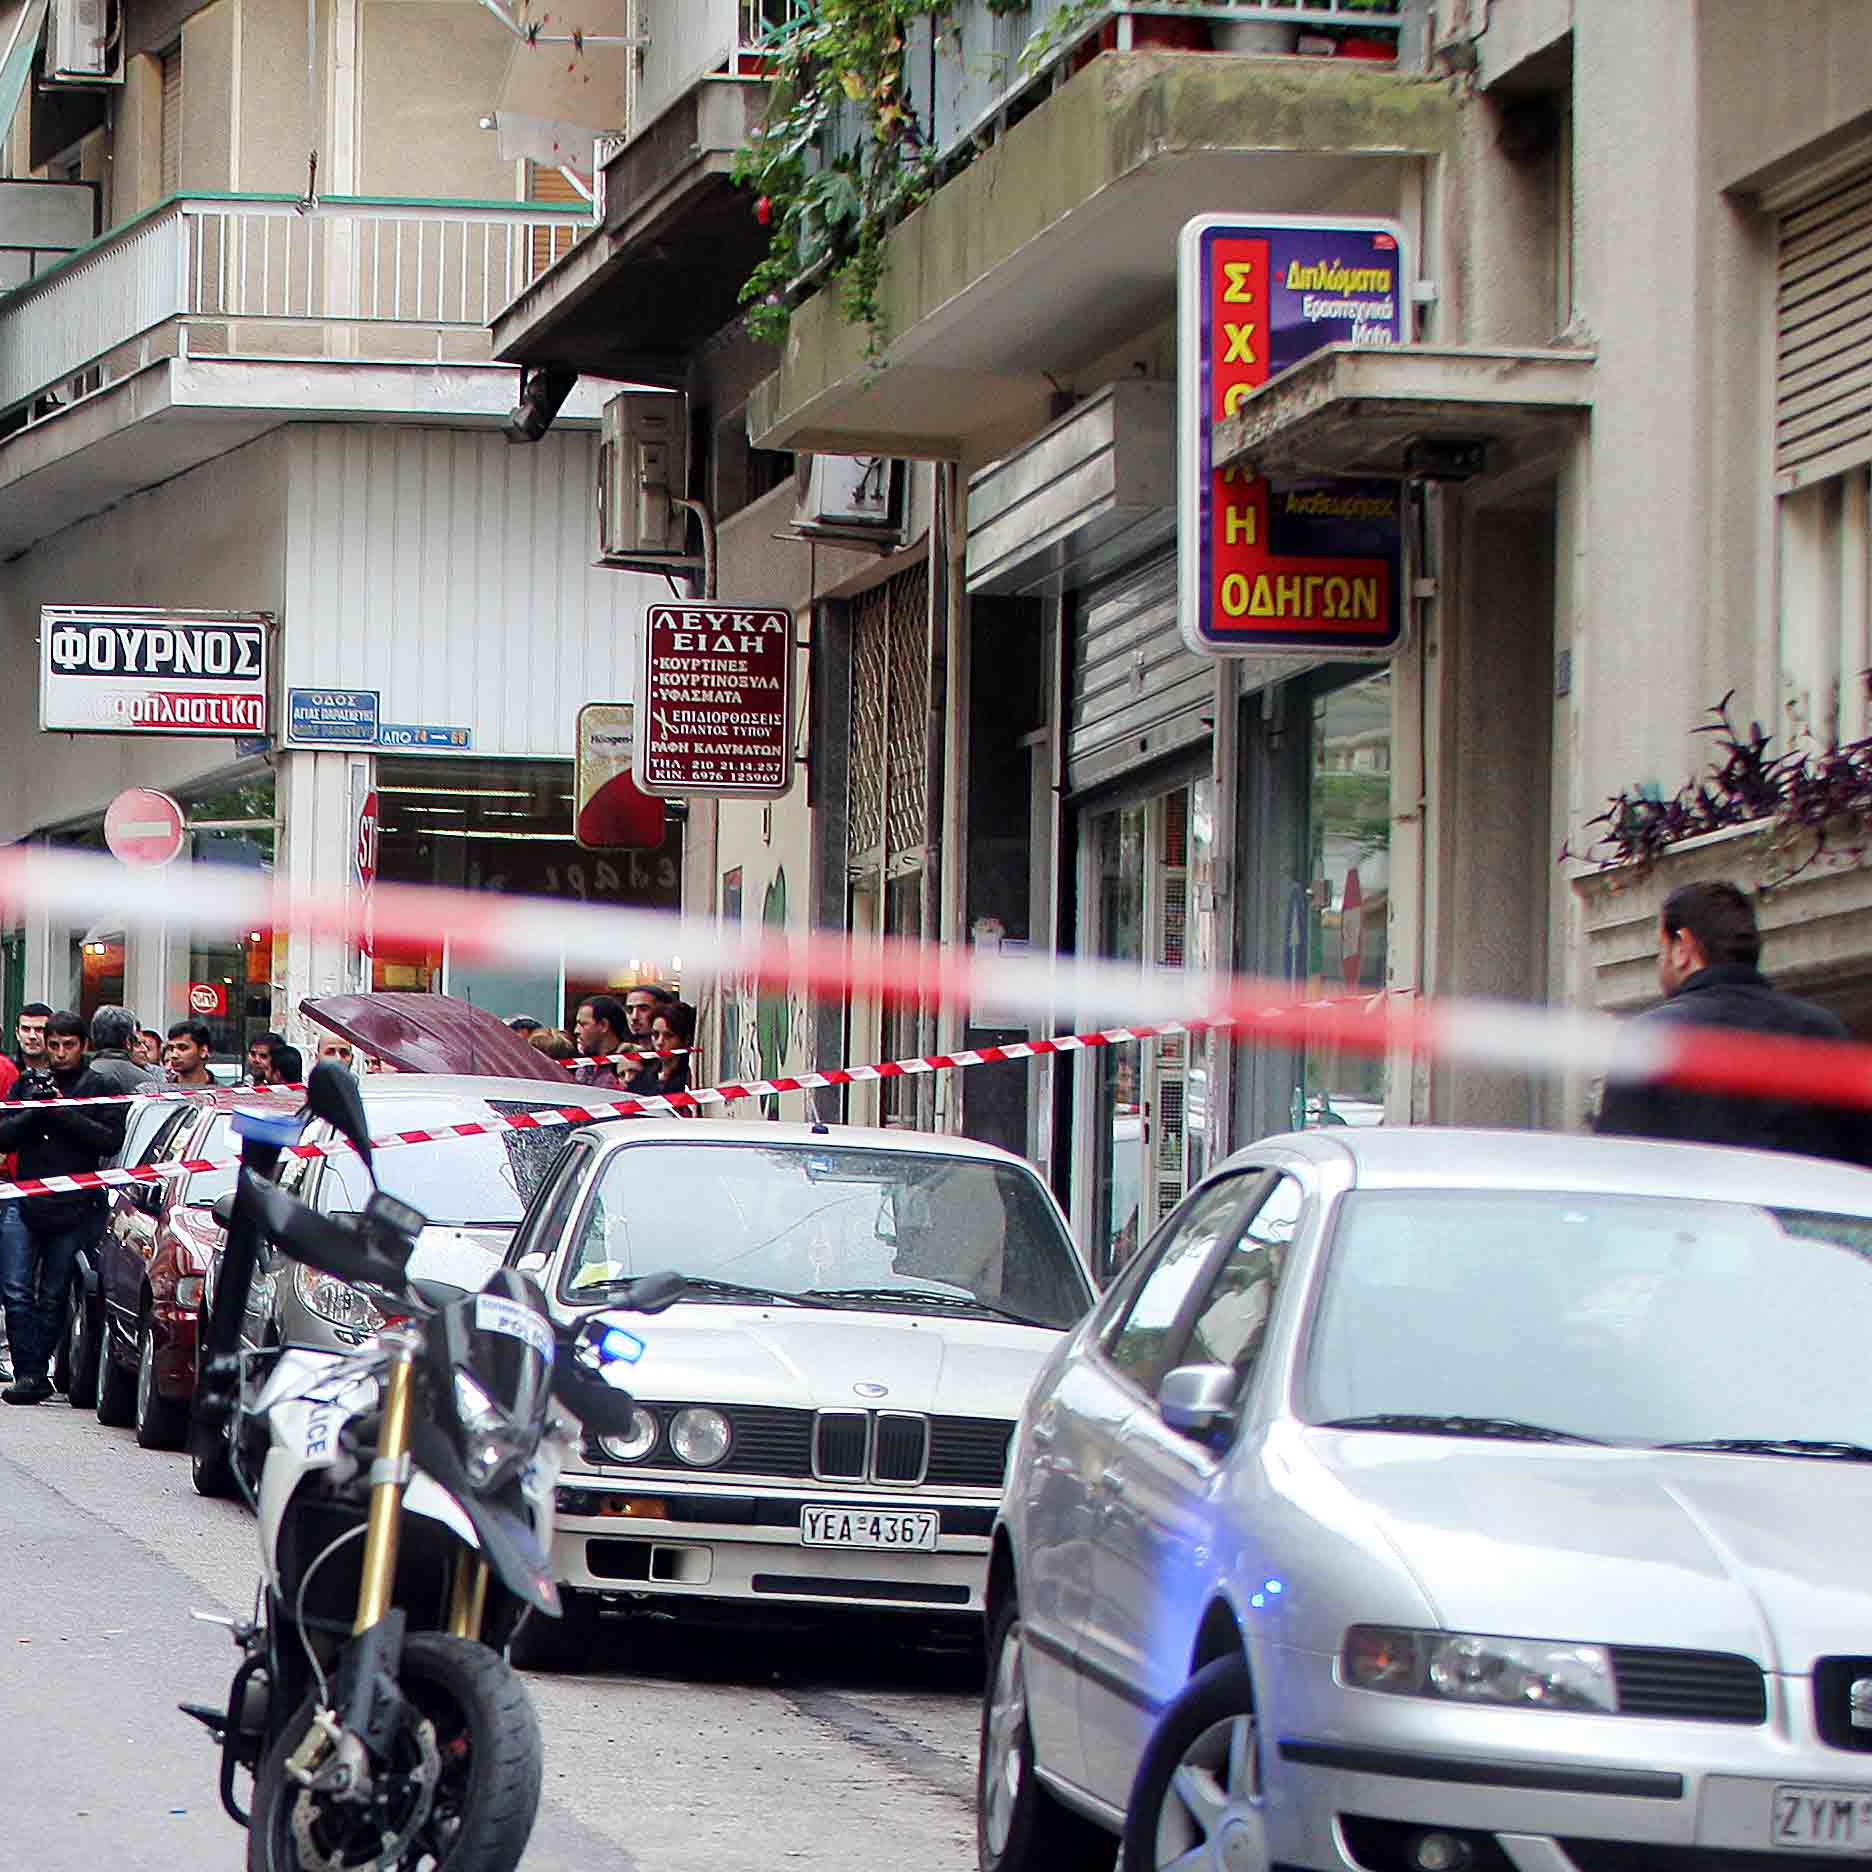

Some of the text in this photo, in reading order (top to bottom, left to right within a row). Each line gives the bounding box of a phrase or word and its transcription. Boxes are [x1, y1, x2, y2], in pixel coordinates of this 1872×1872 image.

[1221, 573, 1378, 620] ΟΔΗΓΩΝ
[655, 611, 784, 633] ΛΕΥΚΑ
[52, 627, 260, 676] ΦΟΥΡΝΟΣ
[673, 633, 764, 654] ΕΙΔΗ
[659, 657, 749, 673] ΚΟΥΡΤΙΝΕΣ
[659, 673, 781, 690] ΚΟΥΡΤΙΝΟΞΥΛΑ
[311, 694, 358, 708] ΟΔΟΣ
[659, 688, 743, 704] ΥΦΑΣΜΑΤΑ
[672, 710, 783, 726] ΕΠΙΔΙΟΡΘΩΣΕΙΣ
[680, 724, 773, 738] ΠΑΝΤΟΣ ΤΥΠΟΥ
[651, 741, 689, 754] ΡΑΦΗ
[692, 760, 714, 770] 210
[655, 769, 686, 781] ΚΙΝ.
[692, 770, 724, 781] 6976
